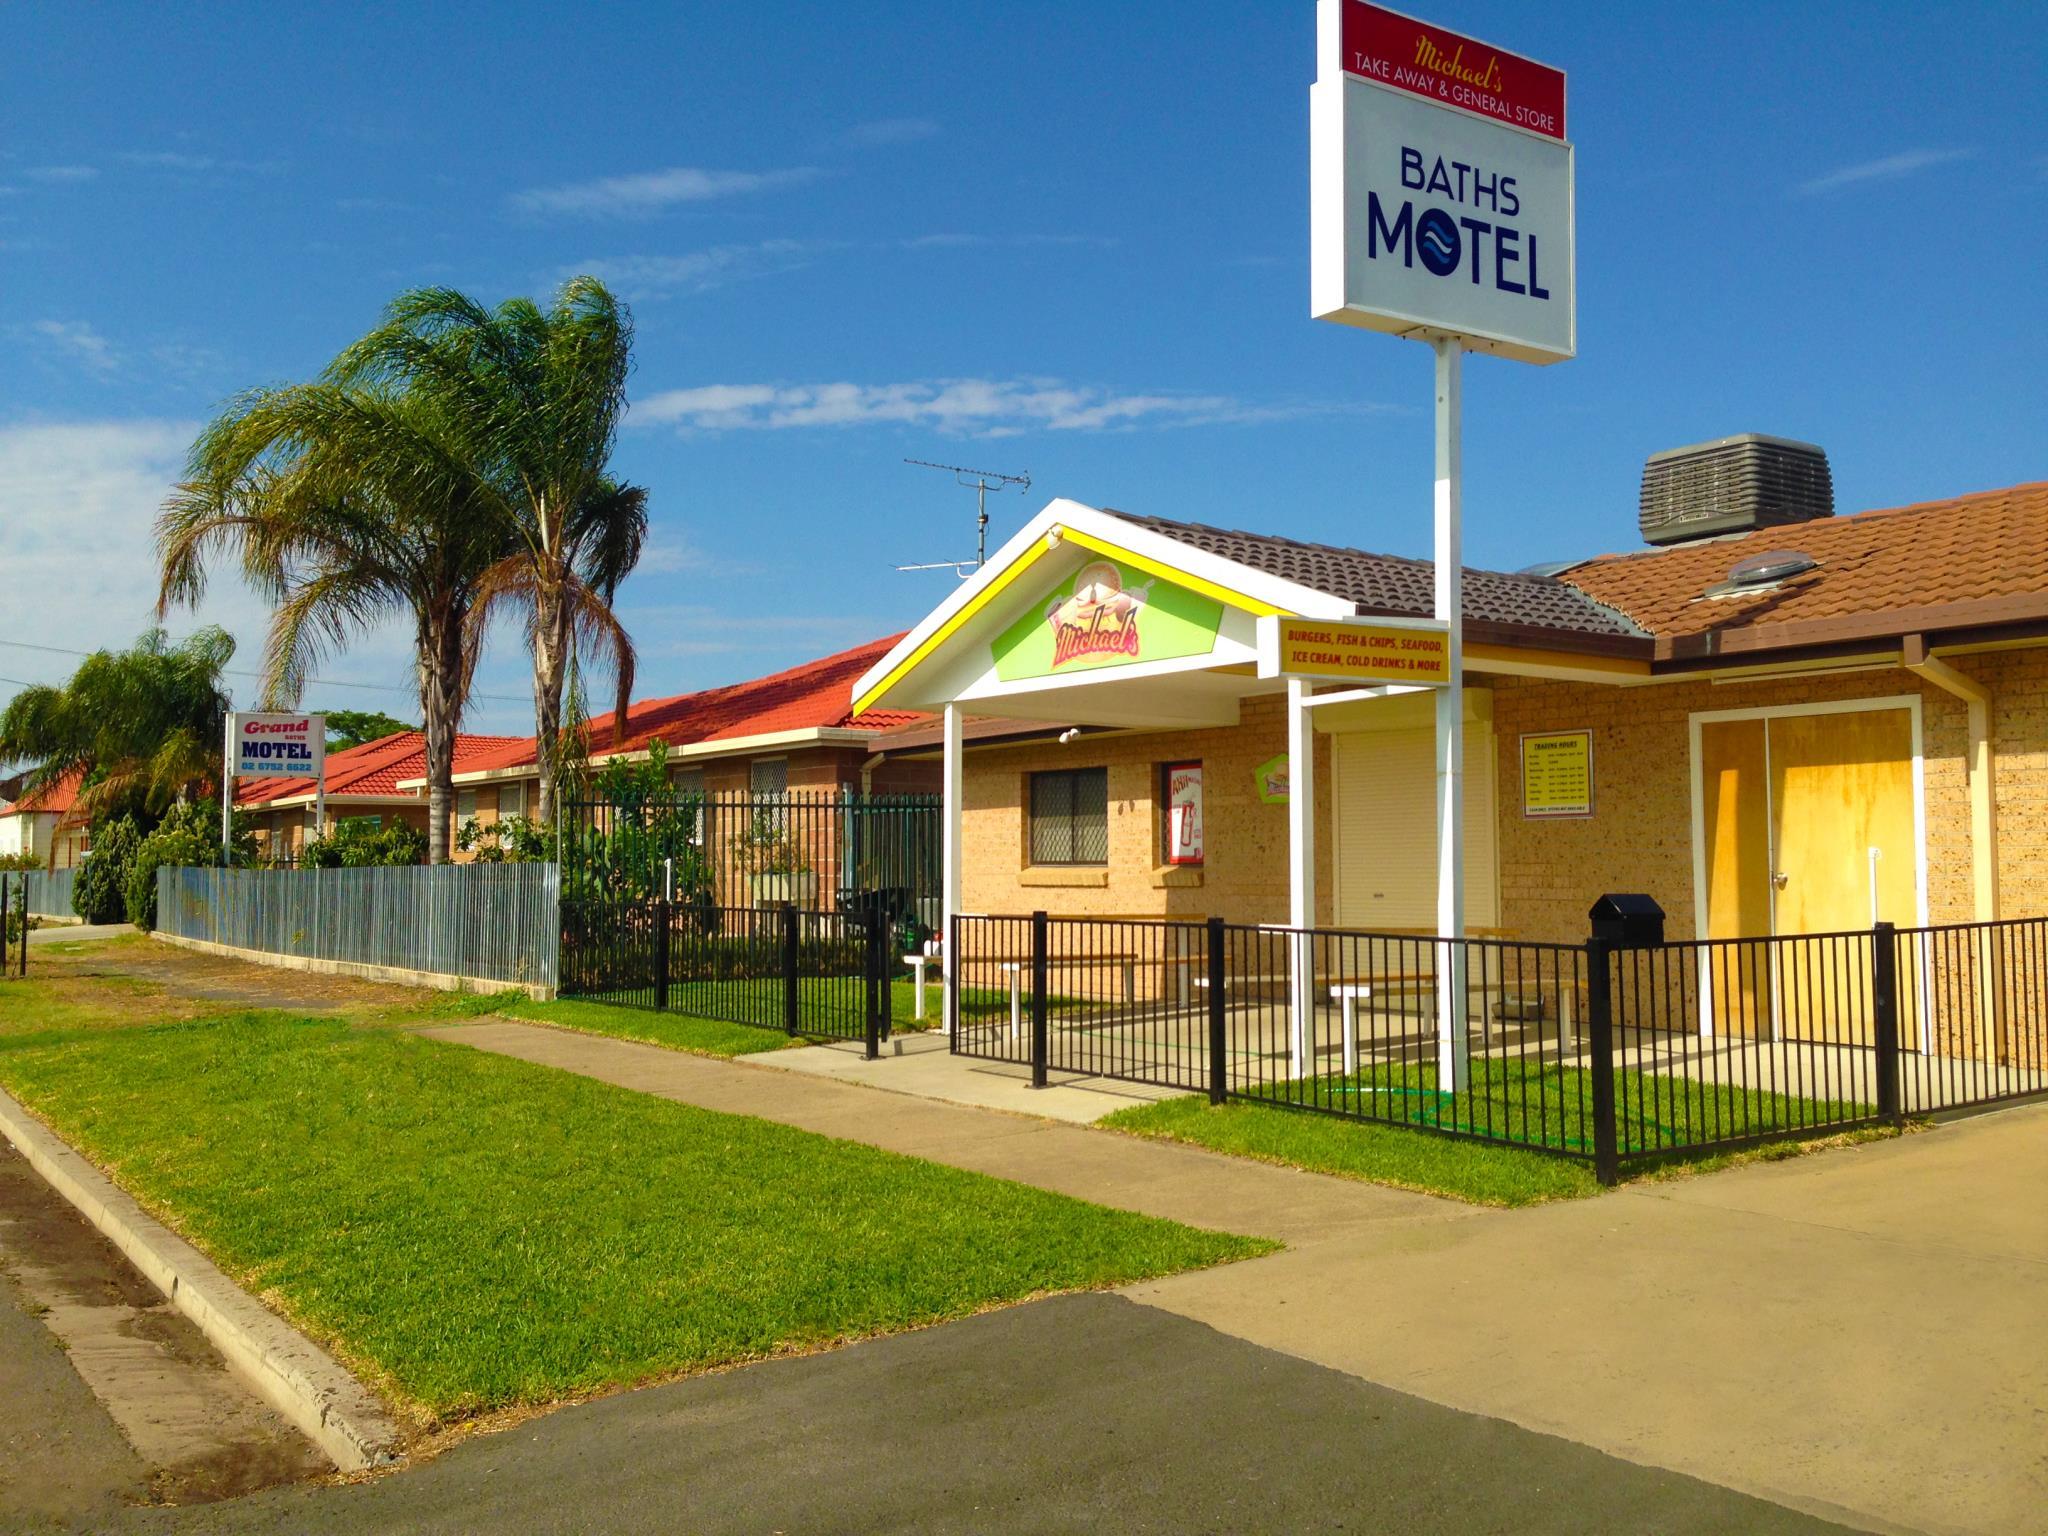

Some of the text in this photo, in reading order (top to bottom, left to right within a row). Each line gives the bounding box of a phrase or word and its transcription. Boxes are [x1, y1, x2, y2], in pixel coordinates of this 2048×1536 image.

[1414, 34, 1502, 92] Michael's
[1355, 52, 1554, 131] TAKE AWAY & GENERAL STORE
[1401, 146, 1520, 216] BATHS
[1368, 190, 1549, 300] MOTEL
[1053, 603, 1139, 667] Michael's
[1288, 630, 1444, 654] BURGERS, FISH & CHIPS, SEAFOOD,
[1292, 651, 1441, 671] ICE CREAM, COLD DRINKS & MORE
[244, 719, 309, 734] Grand
[241, 762, 255, 770] 02
[242, 741, 312, 759] MOTEL
